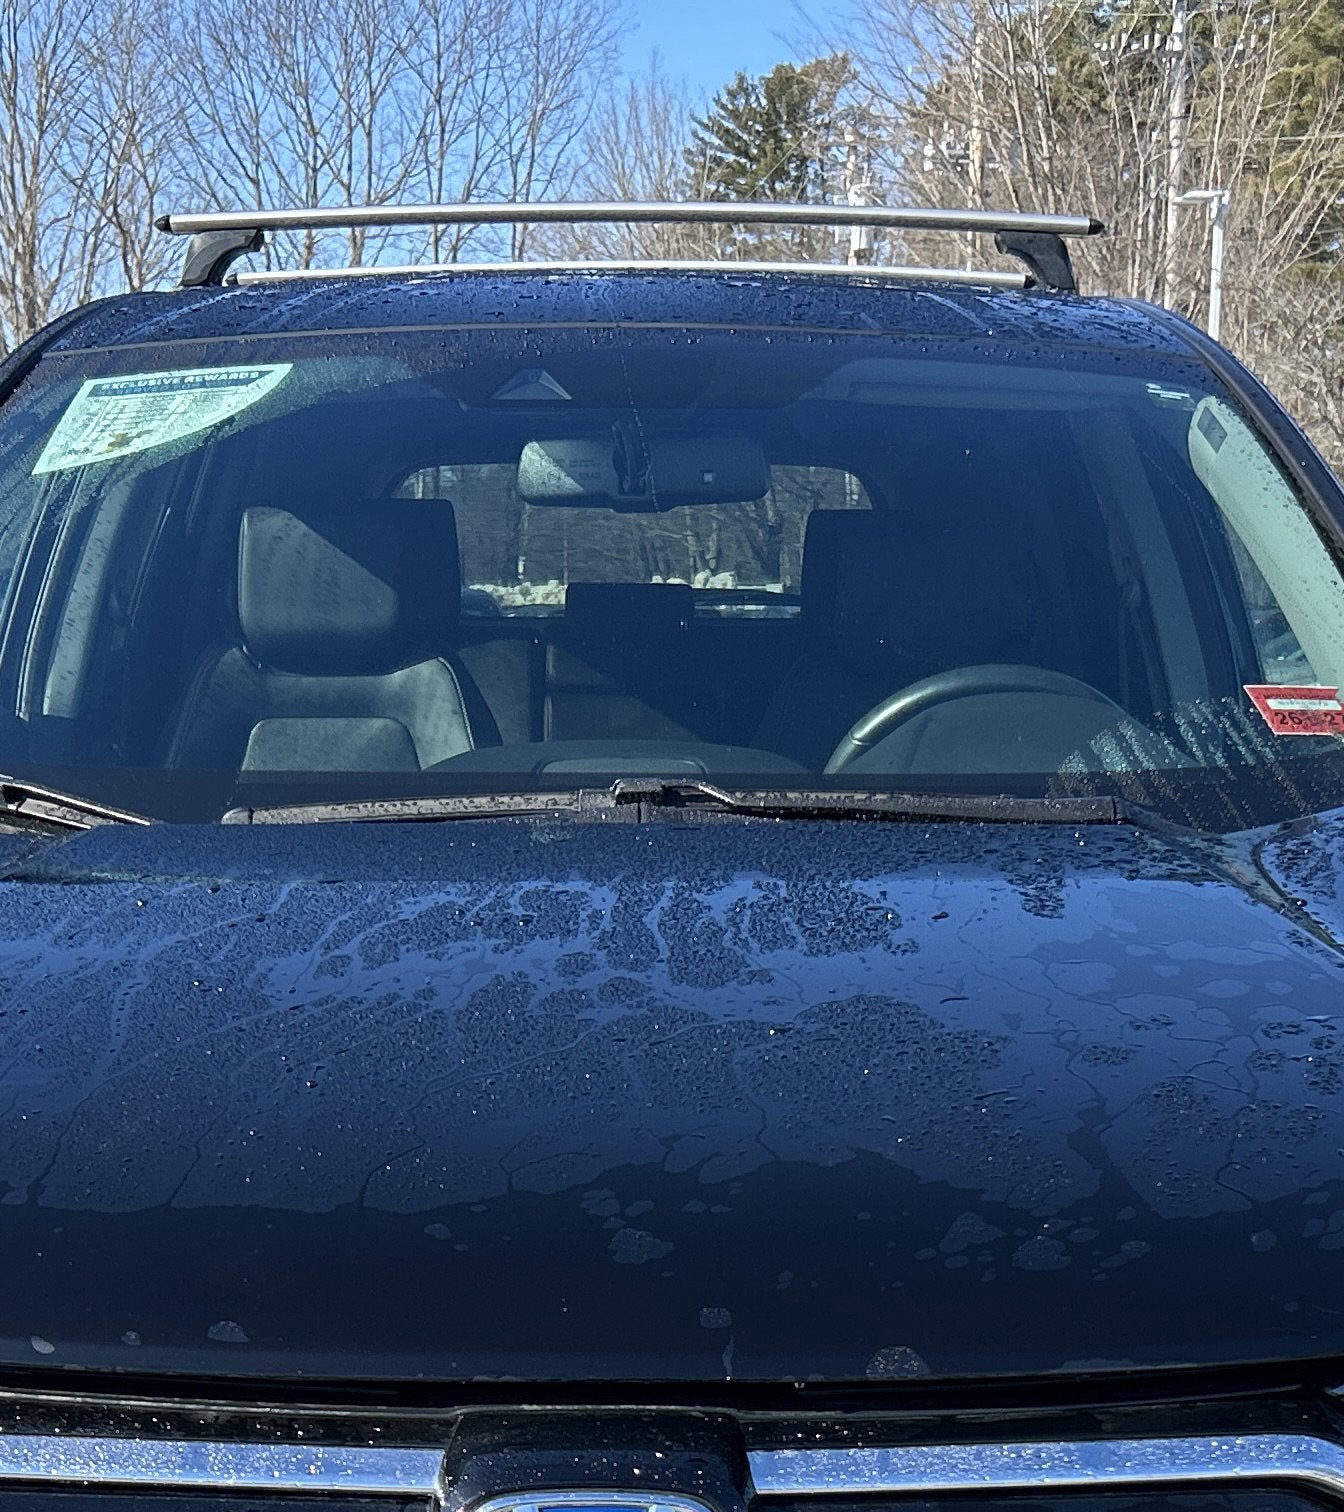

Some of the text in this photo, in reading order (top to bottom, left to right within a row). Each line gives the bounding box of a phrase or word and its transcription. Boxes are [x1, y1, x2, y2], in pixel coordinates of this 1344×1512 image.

[102, 371, 259, 390] EXCLUSIVE REWARDS
[1274, 711, 1303, 725] 26
